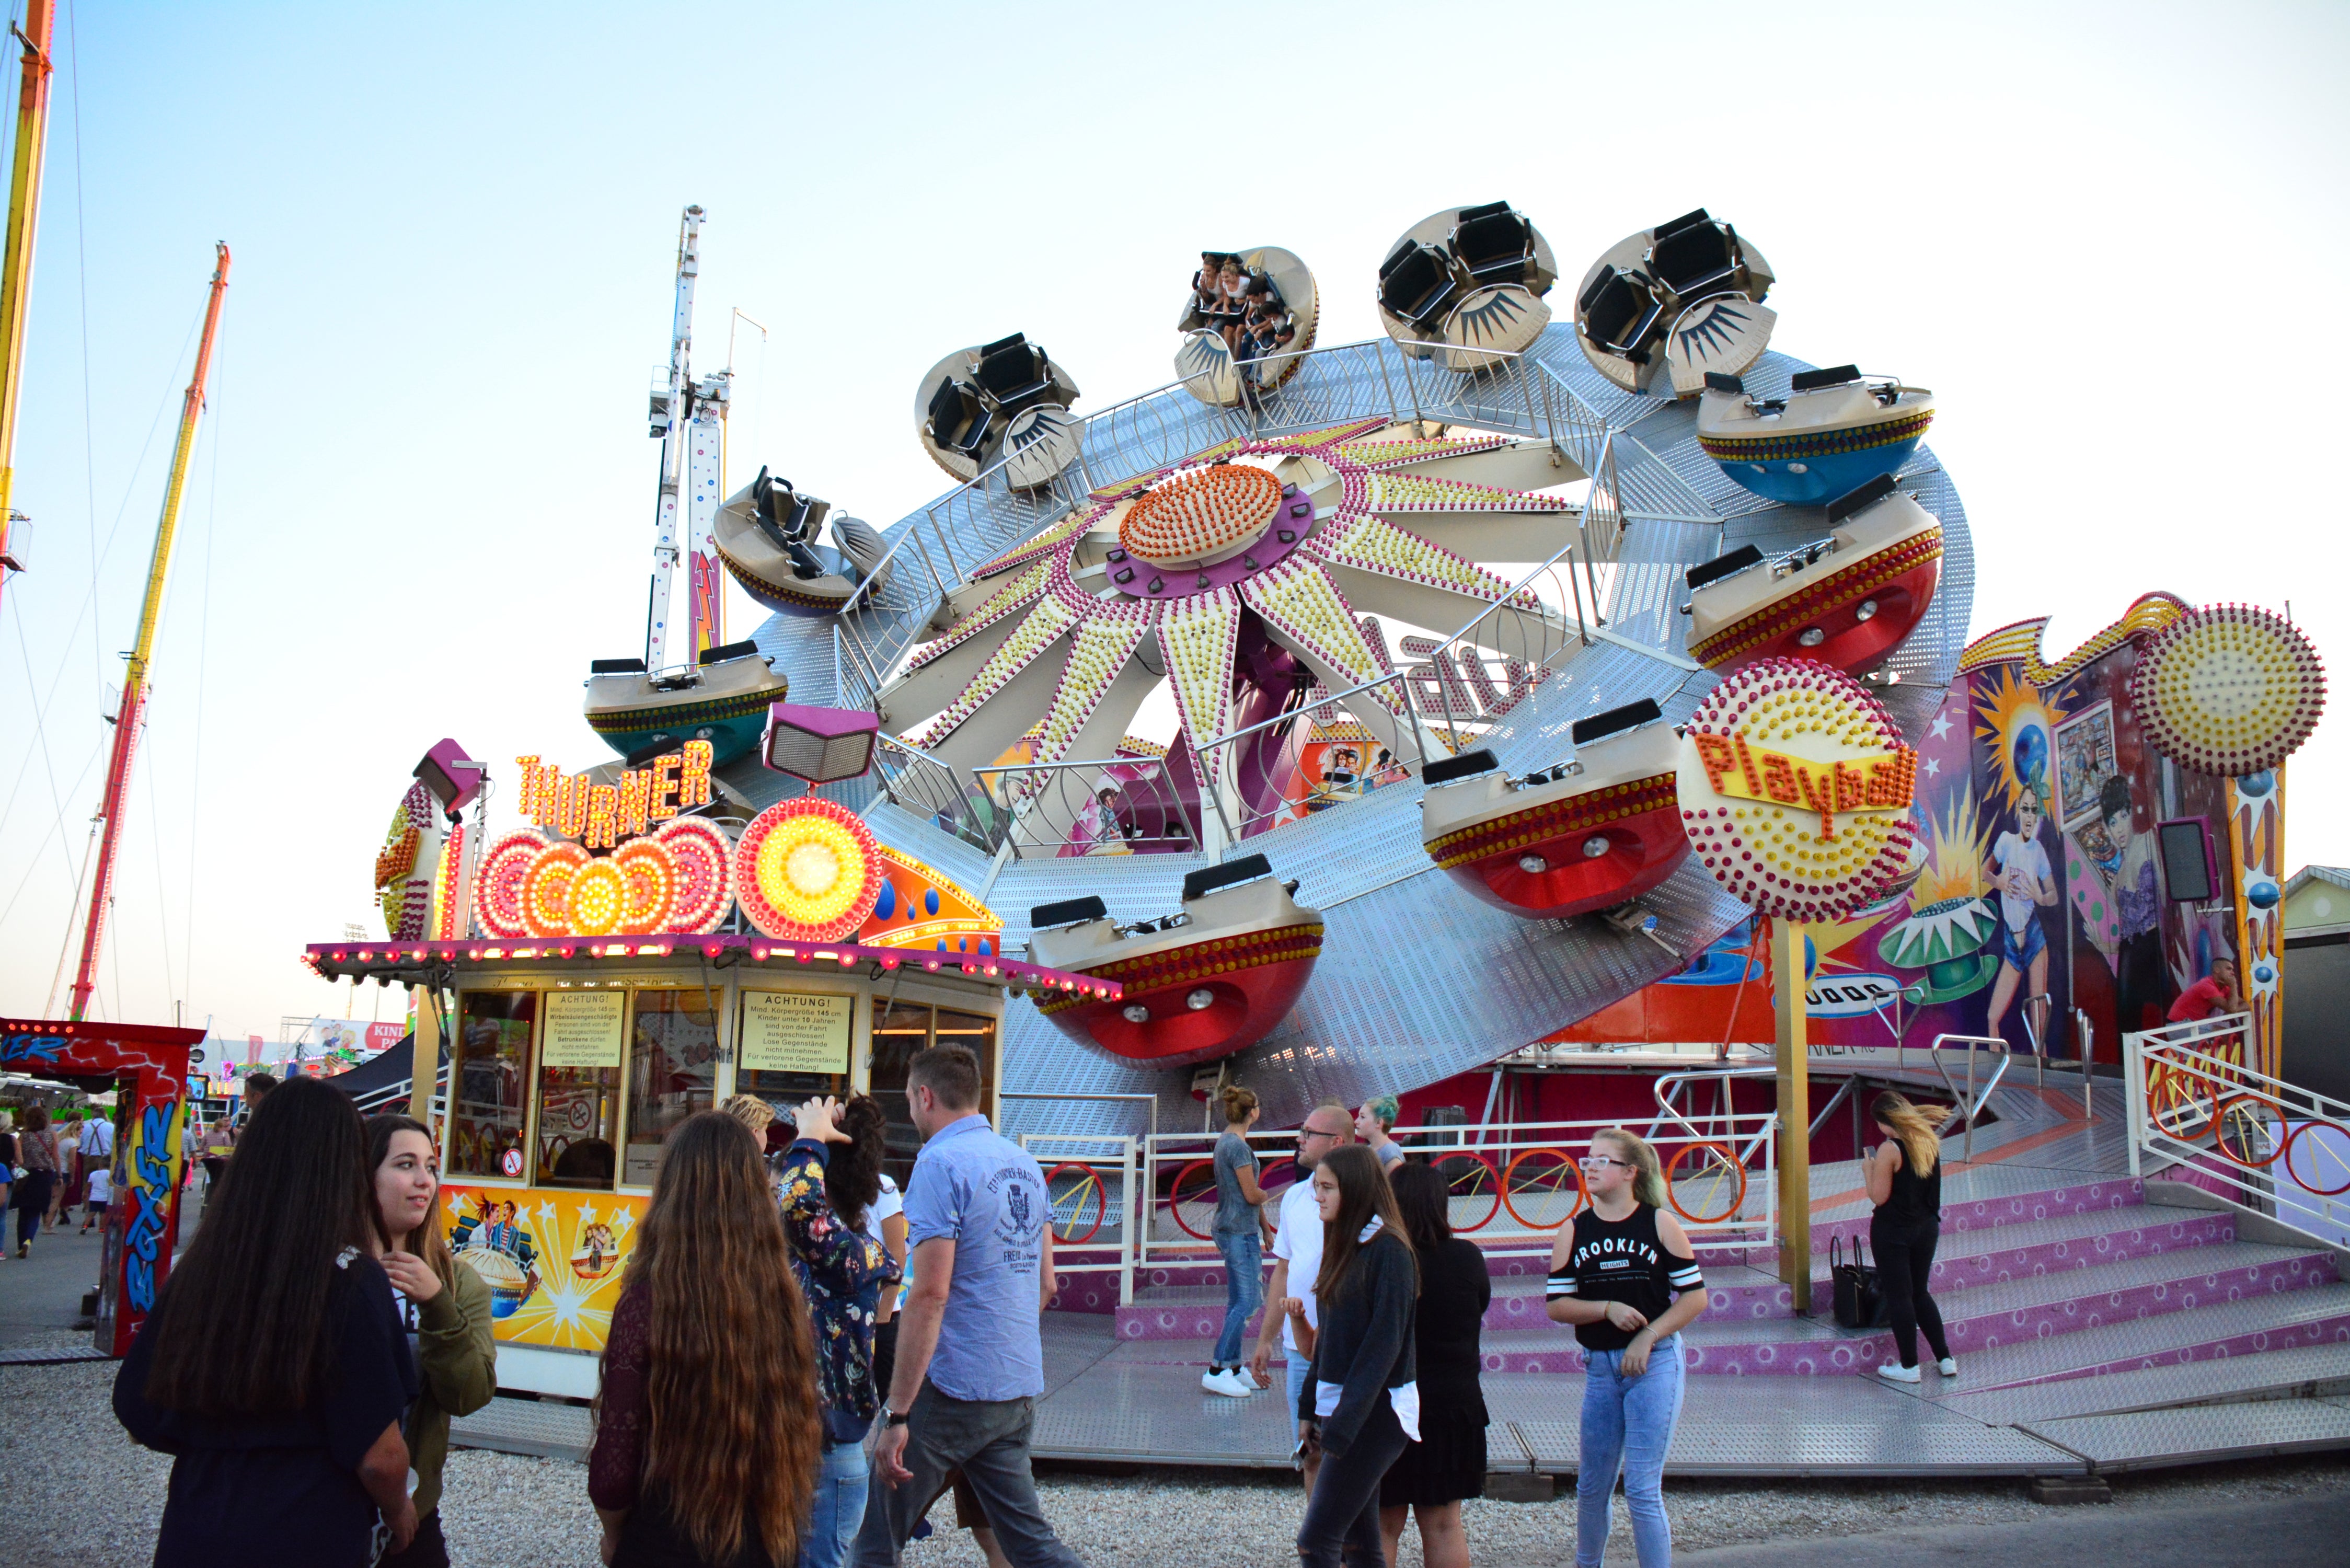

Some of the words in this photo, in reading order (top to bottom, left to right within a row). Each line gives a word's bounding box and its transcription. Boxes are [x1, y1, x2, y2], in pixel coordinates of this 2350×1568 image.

[515, 740, 714, 848] THURNER
[765, 996, 830, 1007] ACHTUNG!
[772, 1007, 814, 1016] Körpergröße
[782, 1039, 827, 1047] Gegenstände
[125, 1101, 176, 1313] BOXER
[1574, 1238, 1658, 1269] BROOKLYN
